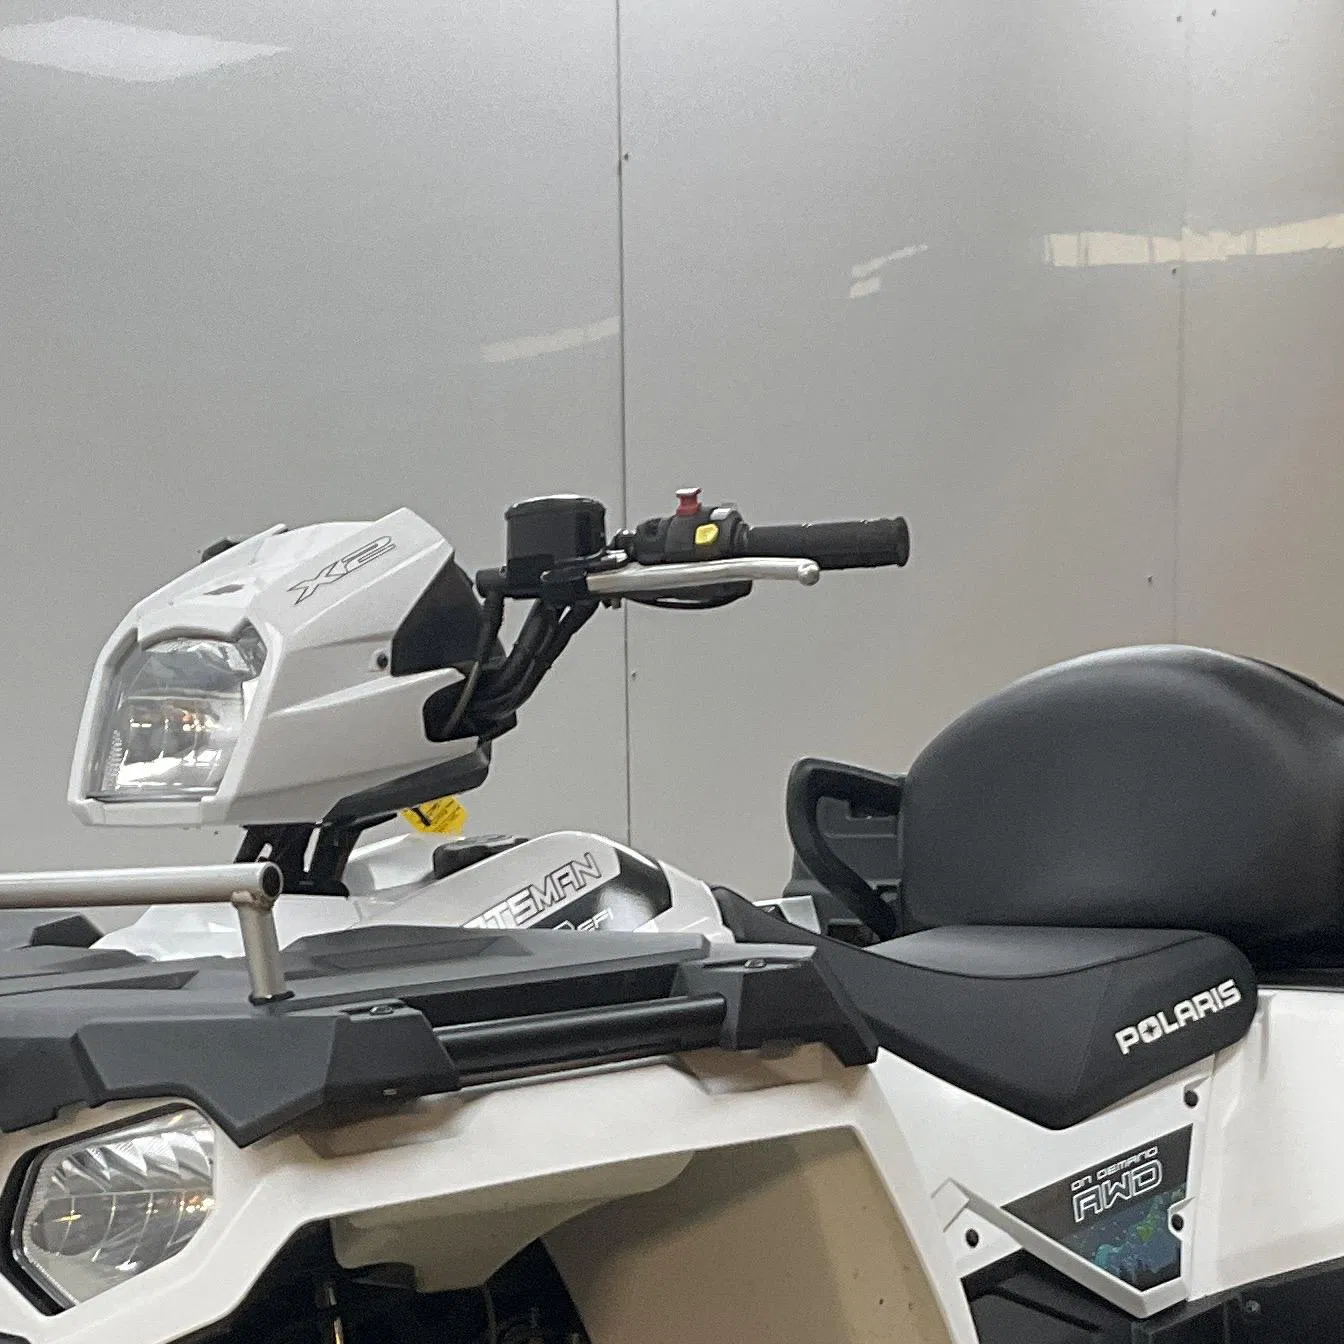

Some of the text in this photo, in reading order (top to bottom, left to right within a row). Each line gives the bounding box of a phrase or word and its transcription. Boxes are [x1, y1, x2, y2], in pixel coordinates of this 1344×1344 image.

[462, 851, 603, 929] TSMAN
[1114, 978, 1242, 1056] POLARIS
[1072, 1159, 1163, 1223] AWD
